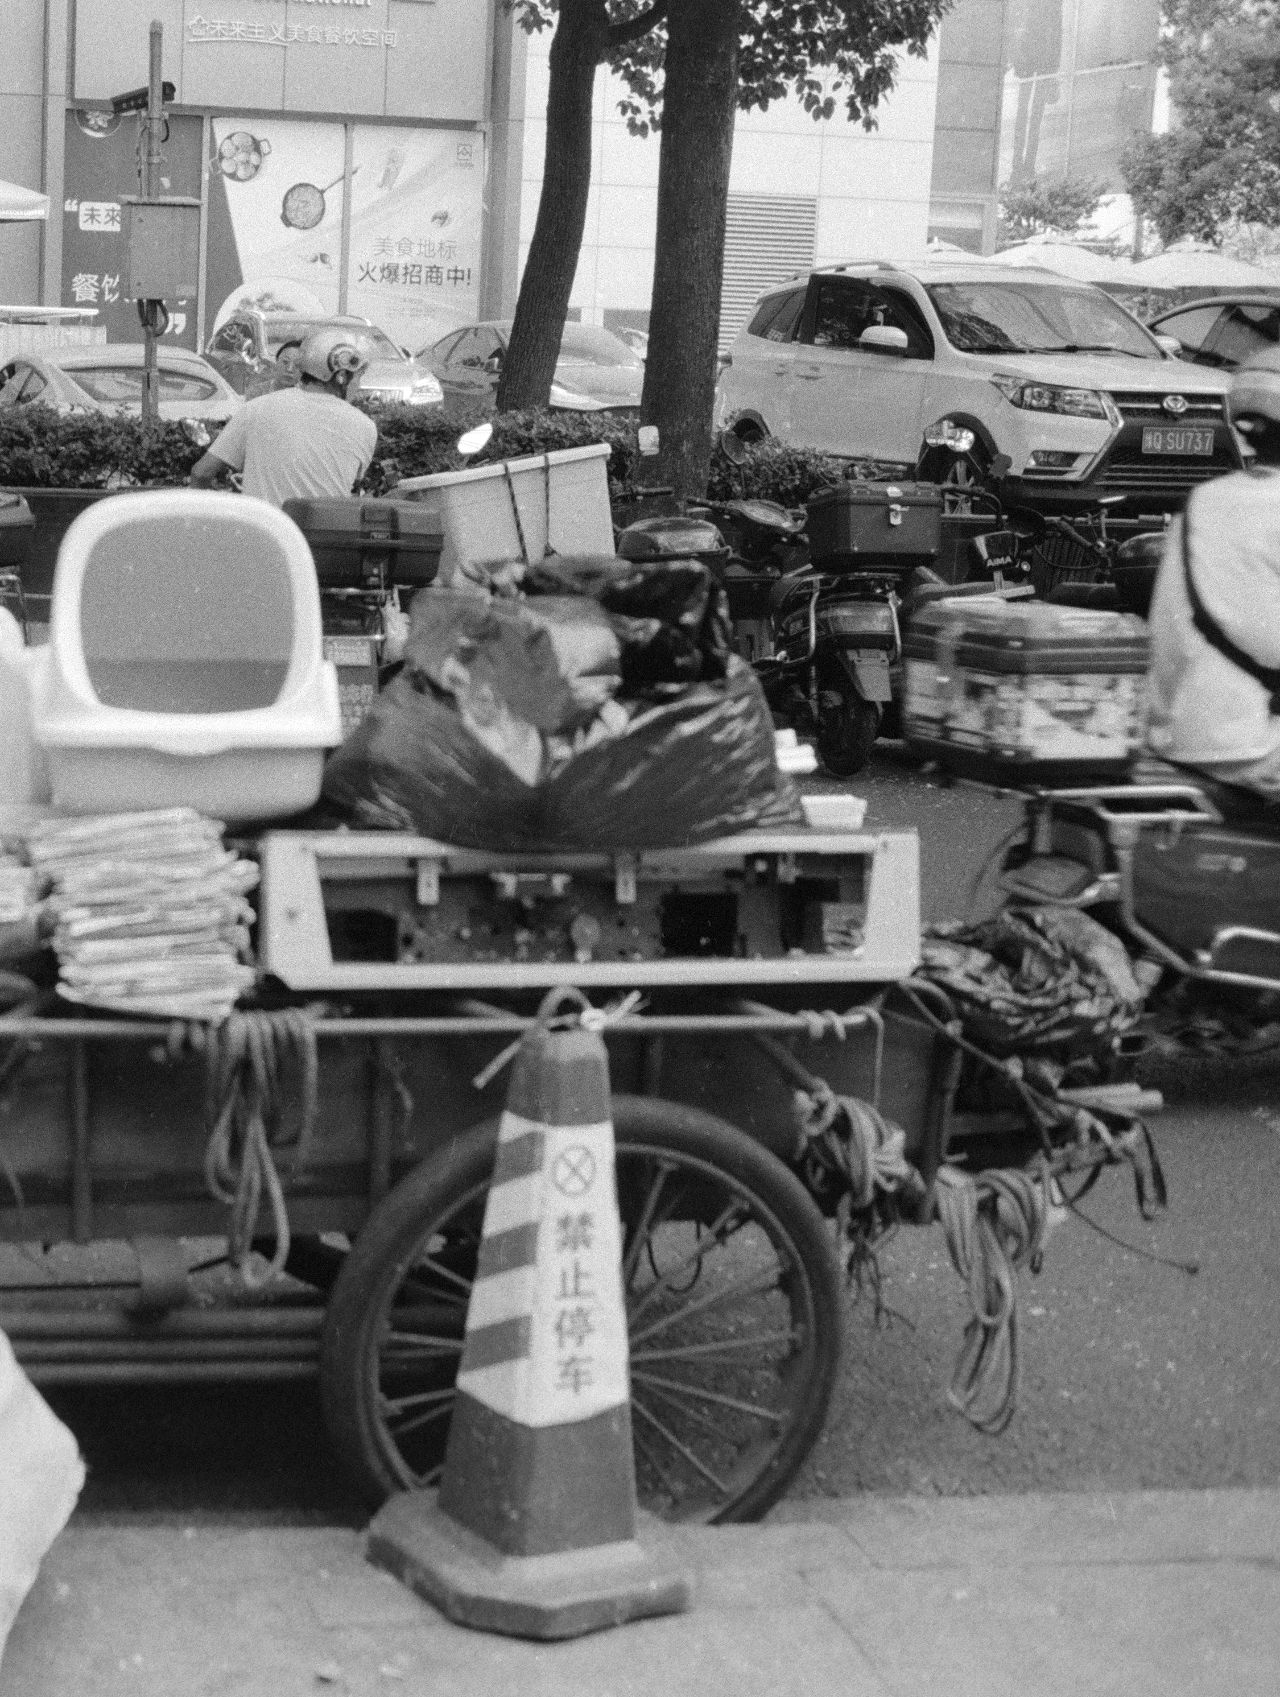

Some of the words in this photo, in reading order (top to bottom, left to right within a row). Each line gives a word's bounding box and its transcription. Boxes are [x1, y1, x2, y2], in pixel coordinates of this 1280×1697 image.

[373, 236, 458, 260] 美食地标
[358, 262, 471, 287] 火爆招商中!
[986, 555, 1013, 568] AIMA
[555, 1212, 596, 1395] 禁止停车
